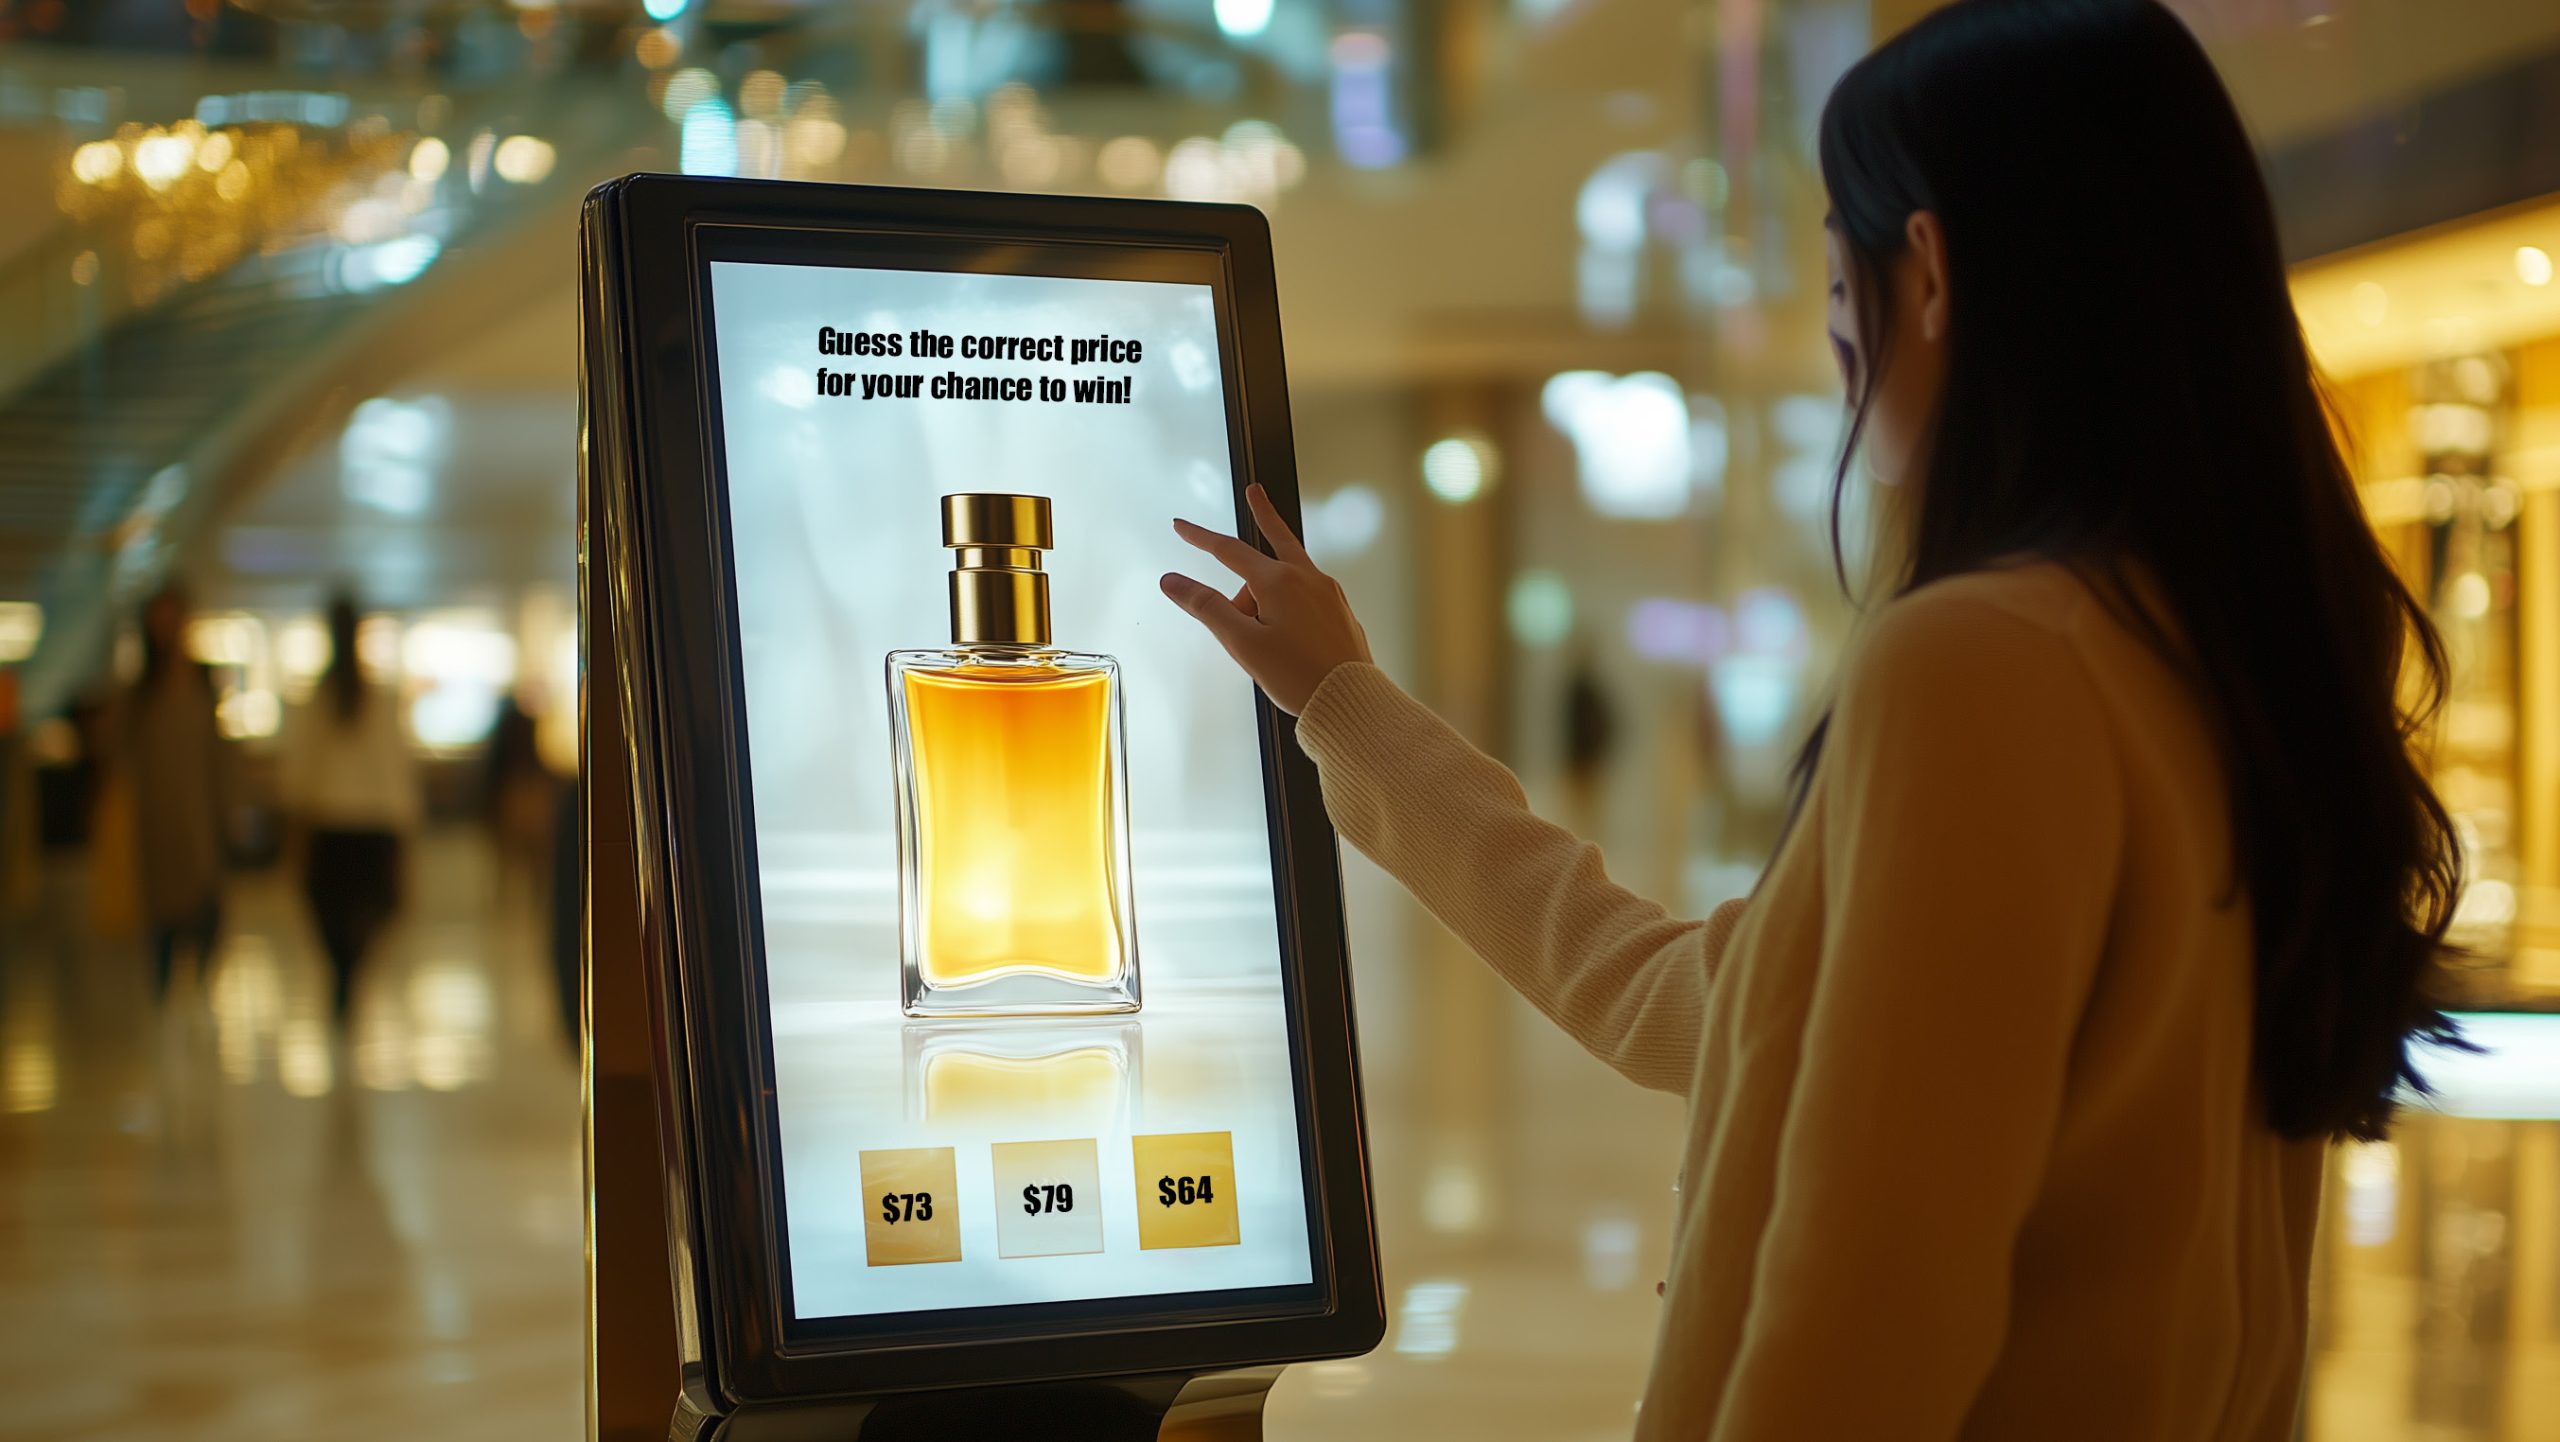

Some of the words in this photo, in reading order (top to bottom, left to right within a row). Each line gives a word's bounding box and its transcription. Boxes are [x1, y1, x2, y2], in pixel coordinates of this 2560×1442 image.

[818, 326, 903, 357] Guess
[909, 329, 954, 359] the
[961, 335, 1064, 362] correct
[1070, 334, 1142, 365] price
[816, 367, 856, 397] for
[861, 374, 924, 400] your
[930, 371, 1033, 402] chance
[1039, 376, 1067, 403] to
[1073, 375, 1132, 404] win!
[1023, 1183, 1074, 1217] $79
[1158, 1175, 1214, 1208] $64
[881, 1192, 933, 1226] $73
